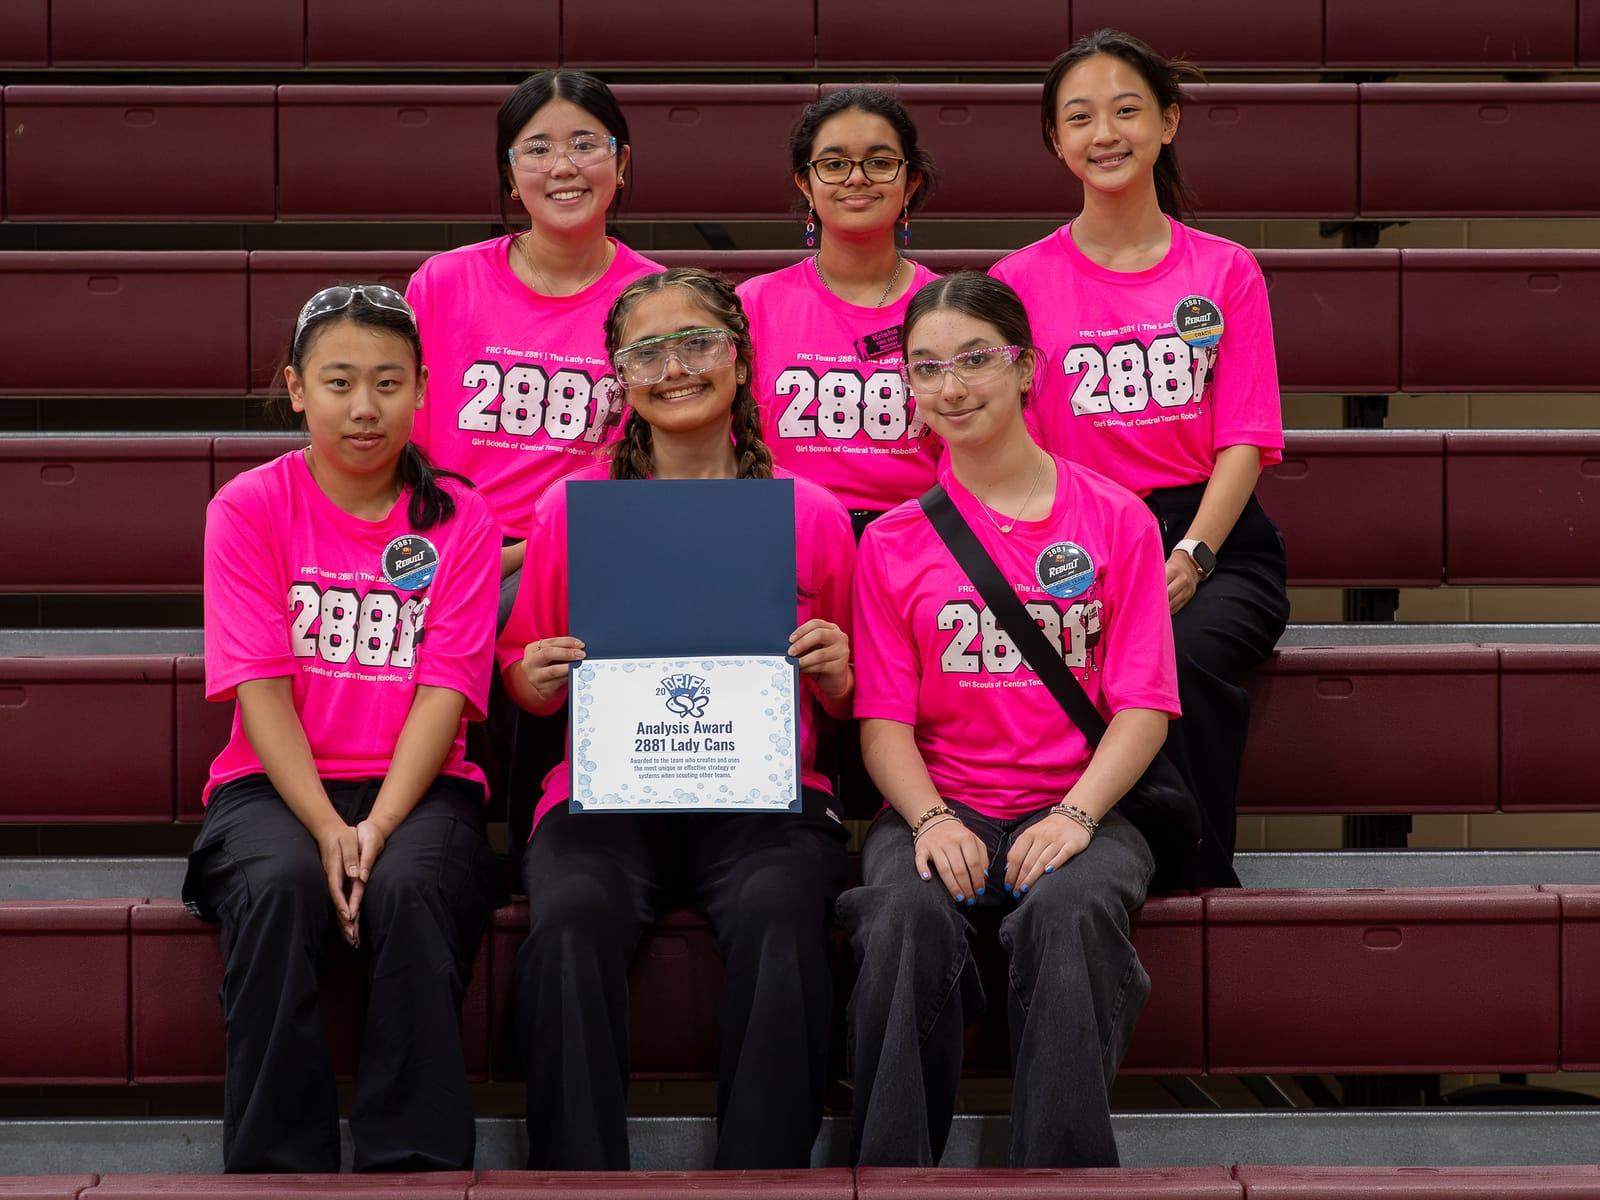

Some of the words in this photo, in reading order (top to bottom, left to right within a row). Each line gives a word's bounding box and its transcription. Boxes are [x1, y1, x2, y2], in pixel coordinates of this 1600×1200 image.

[1120, 325, 1135, 334] 2881
[503, 347, 522, 357] Team
[524, 350, 542, 359] 2881
[549, 354, 563, 362] The
[565, 356, 583, 364] Lady
[585, 357, 605, 365] Cans
[815, 354, 836, 362] Team
[458, 360, 617, 443] 2881
[1136, 416, 1160, 426] Central
[486, 440, 510, 449] Scouts
[1049, 558, 1078, 578] REBUILT
[360, 572, 375, 580] The
[376, 574, 389, 583] La
[1017, 584, 1030, 592] The
[357, 673, 376, 681] Texas
[637, 722, 689, 736] Analysis
[694, 721, 732, 734] Award
[635, 739, 667, 751] 2881
[671, 739, 700, 753] Lady
[704, 738, 735, 751] Cans
